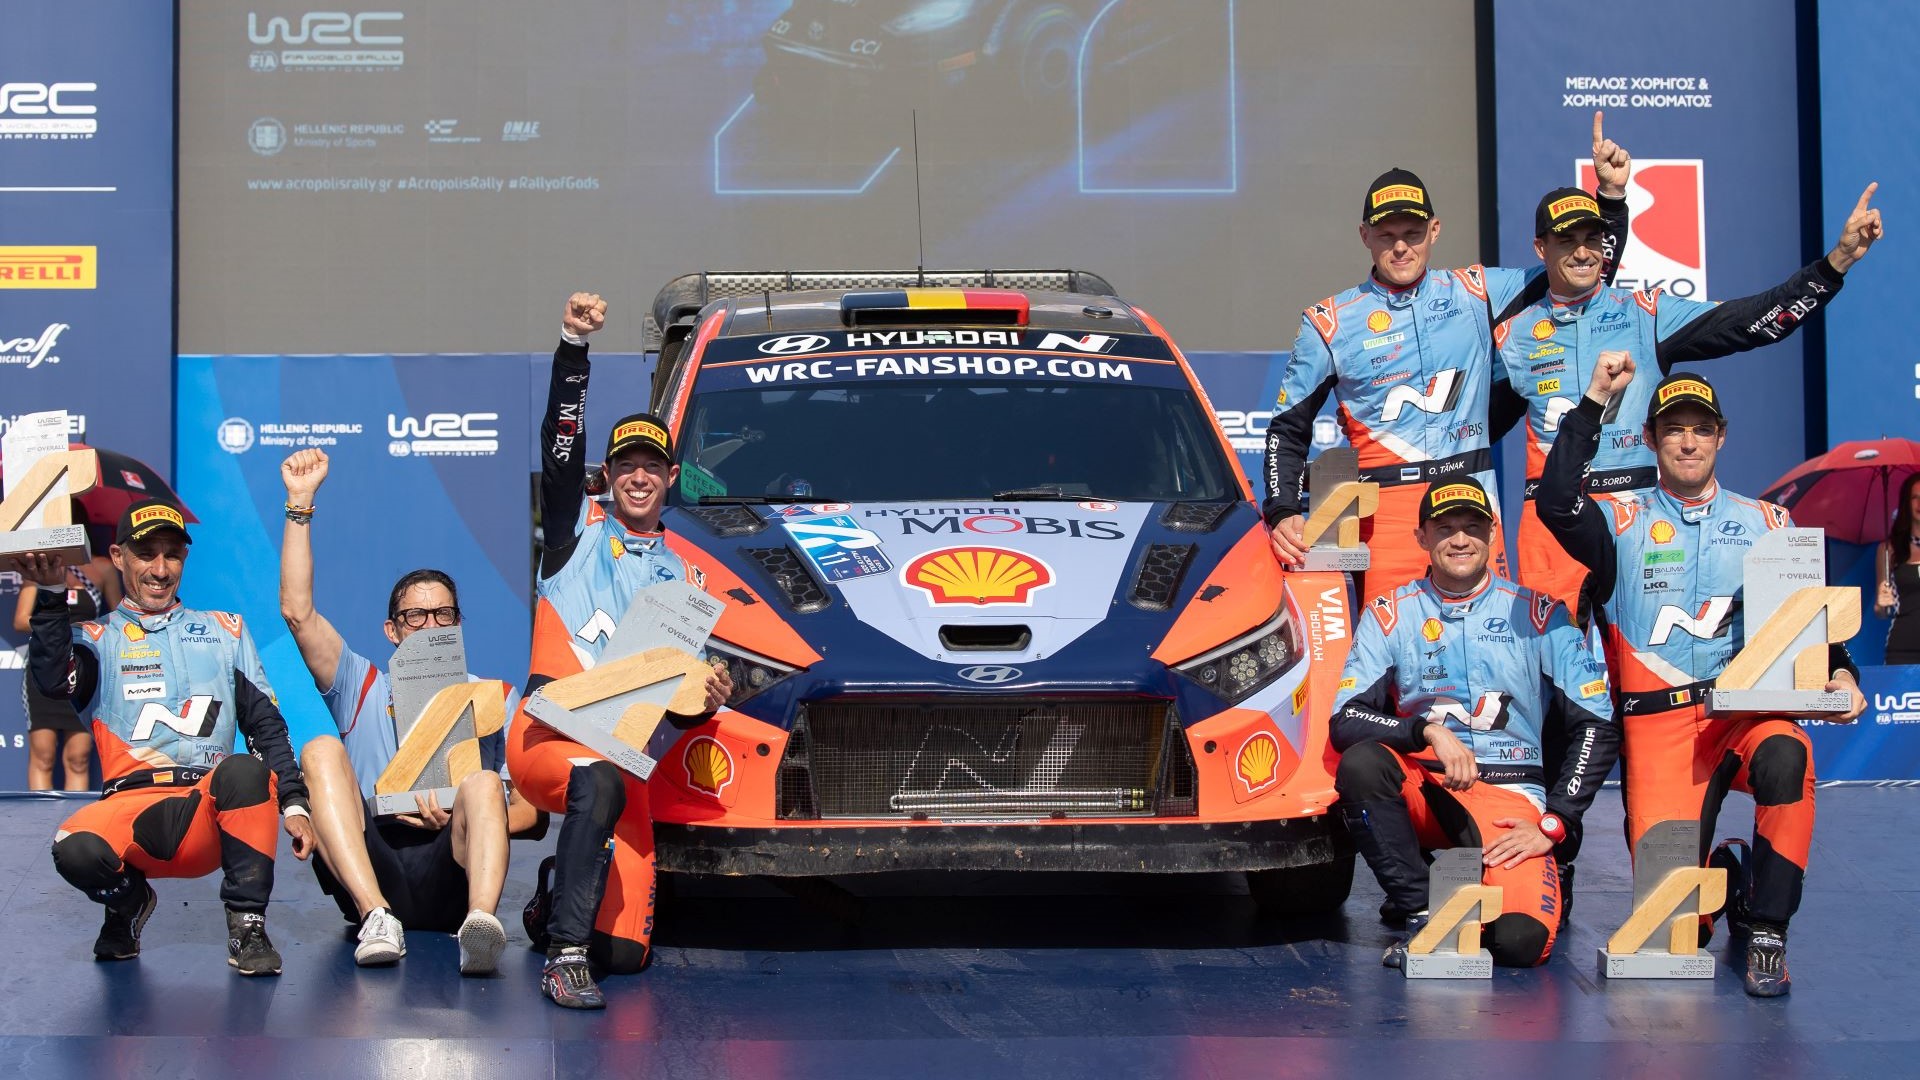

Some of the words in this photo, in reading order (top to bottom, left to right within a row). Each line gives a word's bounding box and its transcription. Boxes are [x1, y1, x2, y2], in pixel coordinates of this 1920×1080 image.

[248, 12, 404, 44] WRC
[1566, 77, 1628, 90] ΜΕΓΑΛΟΣ
[1631, 77, 1695, 90] ΧΟΡΗΓΟΣ
[1699, 78, 1709, 90] &
[0, 83, 97, 114] RC
[1563, 95, 1628, 107] ΧΟΡΗΓΟΣ
[1631, 95, 1712, 107] ΟΝΟΜΑΤΟΣ
[294, 124, 347, 134] HELLENIC
[350, 124, 405, 134] REPUBLIC
[398, 176, 504, 192] #AcropolisRally
[508, 176, 599, 192] #RallyofGods
[1375, 187, 1420, 204] PIRELLI
[1552, 197, 1598, 215] PIRELLI
[1425, 309, 1463, 324] HYUNDAI
[1747, 304, 1784, 334] HYUNDAI
[1763, 295, 1818, 339] MOBIS
[1591, 322, 1631, 334] HYUNDAI
[847, 331, 1020, 348] HYUNDAI
[745, 356, 1133, 384] WRC-FANSHOP.COM
[1538, 381, 1558, 392] RACC
[1662, 383, 1710, 400] PIRELLI
[260, 424, 310, 434] HELLENIC
[311, 424, 363, 434] REPUBLIC
[388, 413, 498, 438] WRC
[552, 403, 577, 462] MOBIS
[616, 423, 664, 442] PIRELLI
[1449, 422, 1483, 443] MOBIS
[260, 436, 295, 447] Ministry
[296, 436, 306, 446] of
[307, 436, 337, 447] Sports
[1612, 434, 1643, 449] MOBI
[1269, 453, 1280, 498] HYUNDAI
[1429, 467, 1438, 475] O.
[1439, 461, 1465, 474] TÄNAK
[1602, 476, 1632, 486] SORDO
[1434, 487, 1483, 503] PIRELLI
[134, 507, 184, 526] PIRELLI
[865, 507, 1020, 517] HYUNDAI
[899, 516, 1125, 540] MOBIS
[1710, 538, 1752, 547] HYUNDAI
[1644, 581, 1668, 590] LKQ
[688, 595, 716, 614] WRC
[429, 634, 456, 642] WRC
[667, 627, 699, 648] OVERALL
[1310, 611, 1323, 661] HYUNDAI
[1478, 635, 1515, 643] HYUNDAI
[1490, 740, 1522, 748] HYUNDAI
[1500, 747, 1539, 761] MOBIS
